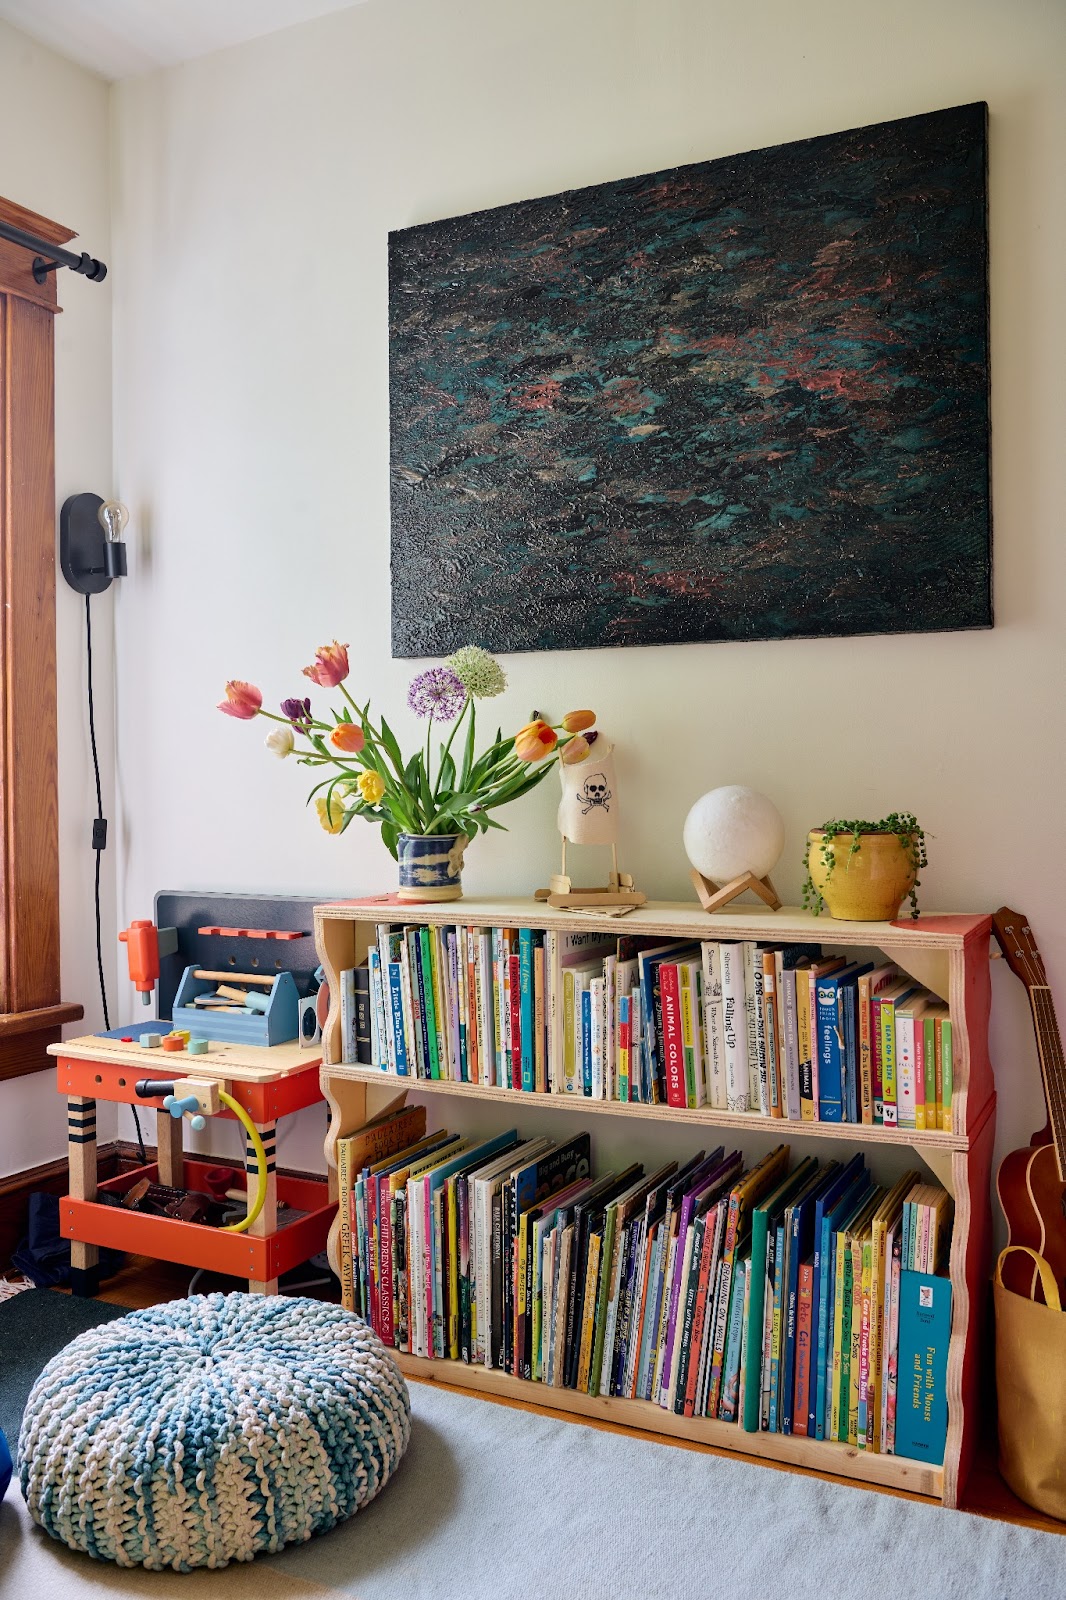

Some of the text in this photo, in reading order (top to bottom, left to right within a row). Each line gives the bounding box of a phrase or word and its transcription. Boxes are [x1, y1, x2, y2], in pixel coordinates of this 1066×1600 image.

[520, 937, 529, 965] Animal
[570, 934, 590, 946] Want
[511, 962, 519, 1006] FERDINAND
[755, 972, 763, 980] O
[391, 986, 399, 1010] Little
[755, 981, 764, 996] BIG
[413, 998, 421, 1020] SPOON
[747, 994, 756, 1015] Attic
[724, 997, 737, 1049] Falling Up
[874, 1015, 882, 1033] BEAR
[665, 995, 679, 1089] ANIMAL COLORS
[712, 1035, 720, 1060] Sidewalk
[748, 1040, 759, 1061] Light
[823, 1025, 833, 1065] feelings
[886, 1043, 892, 1054] ON
[758, 1040, 766, 1069] MISSING
[802, 1062, 810, 1094] ANIMALS
[538, 1150, 581, 1176] Big and Busy
[342, 1210, 348, 1220] OF
[380, 1206, 386, 1216] OF
[341, 1223, 351, 1258] GREEK
[380, 1216, 389, 1275] CHILDREN'S
[701, 1226, 712, 1273] JUNGLE DRUMS
[659, 1249, 667, 1273] FACTORY
[844, 1259, 852, 1278] YERTLE
[343, 1261, 352, 1297] MYTHS
[853, 1272, 861, 1283] THE
[381, 1276, 390, 1322] CLASSICS
[687, 1289, 695, 1307] LITTLE
[853, 1285, 862, 1306] CIRCUS
[695, 1305, 703, 1329] Graeme
[715, 1263, 732, 1351] DRAWING ON WALLS
[799, 1301, 810, 1322] Pete
[862, 1298, 870, 1316] Cars
[861, 1316, 869, 1330] and
[682, 1330, 690, 1348] HAZEL
[799, 1330, 808, 1347] Cat
[861, 1332, 869, 1355] Trucks
[851, 1343, 859, 1359] Seuss
[861, 1357, 867, 1367] on
[860, 1380, 868, 1400] Road
[912, 1353, 923, 1409] and Friends
[923, 1346, 936, 1422] Fun with Mouse
